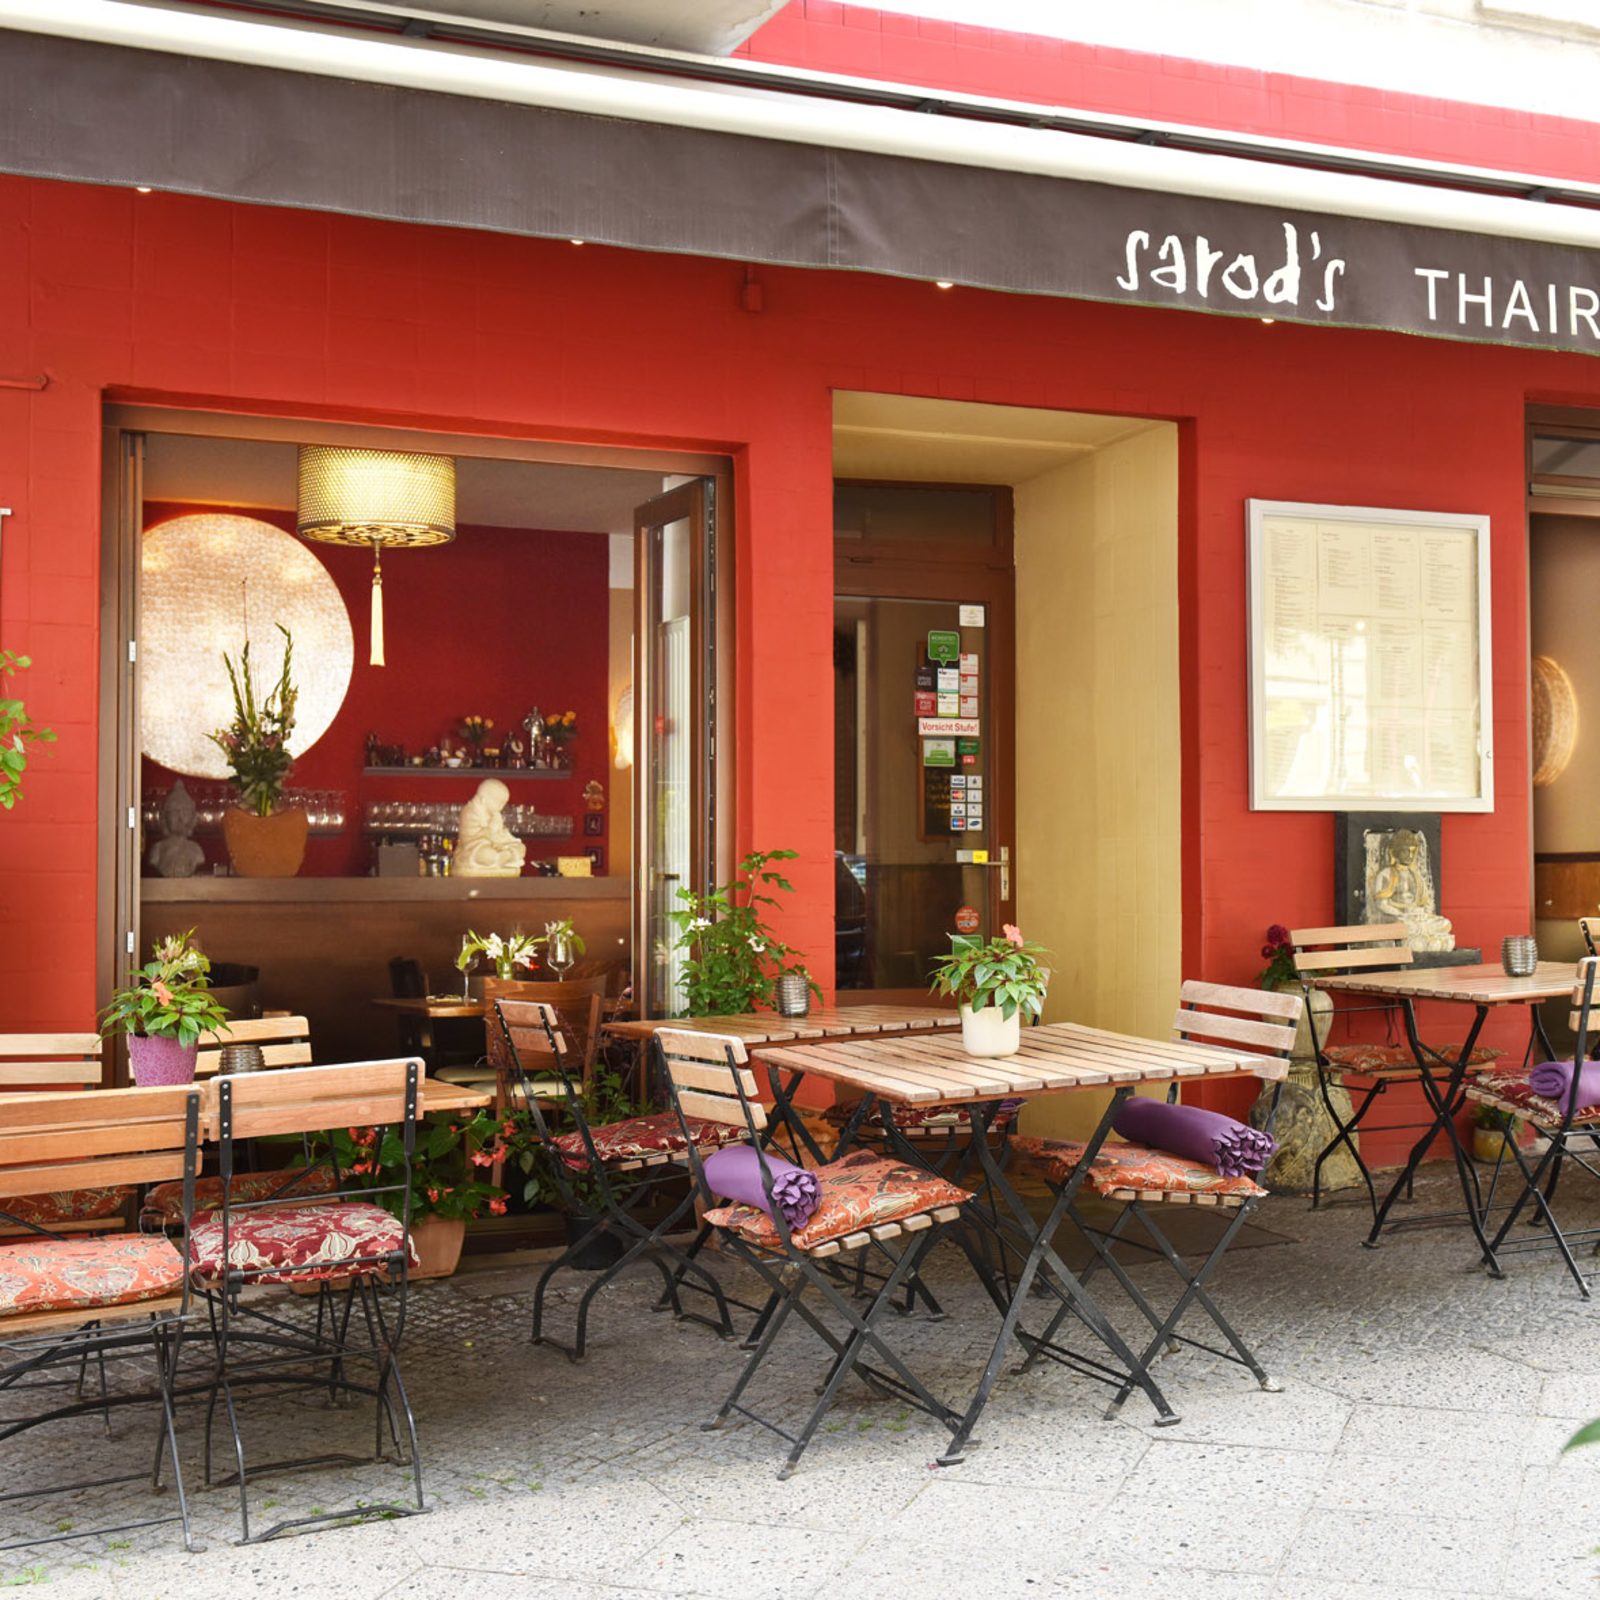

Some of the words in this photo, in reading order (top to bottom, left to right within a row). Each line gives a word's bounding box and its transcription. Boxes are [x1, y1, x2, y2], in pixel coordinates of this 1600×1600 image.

[1116, 222, 1346, 312] sarod's
[1414, 268, 1600, 340] THAIR
[921, 722, 953, 732] Vorsicht
